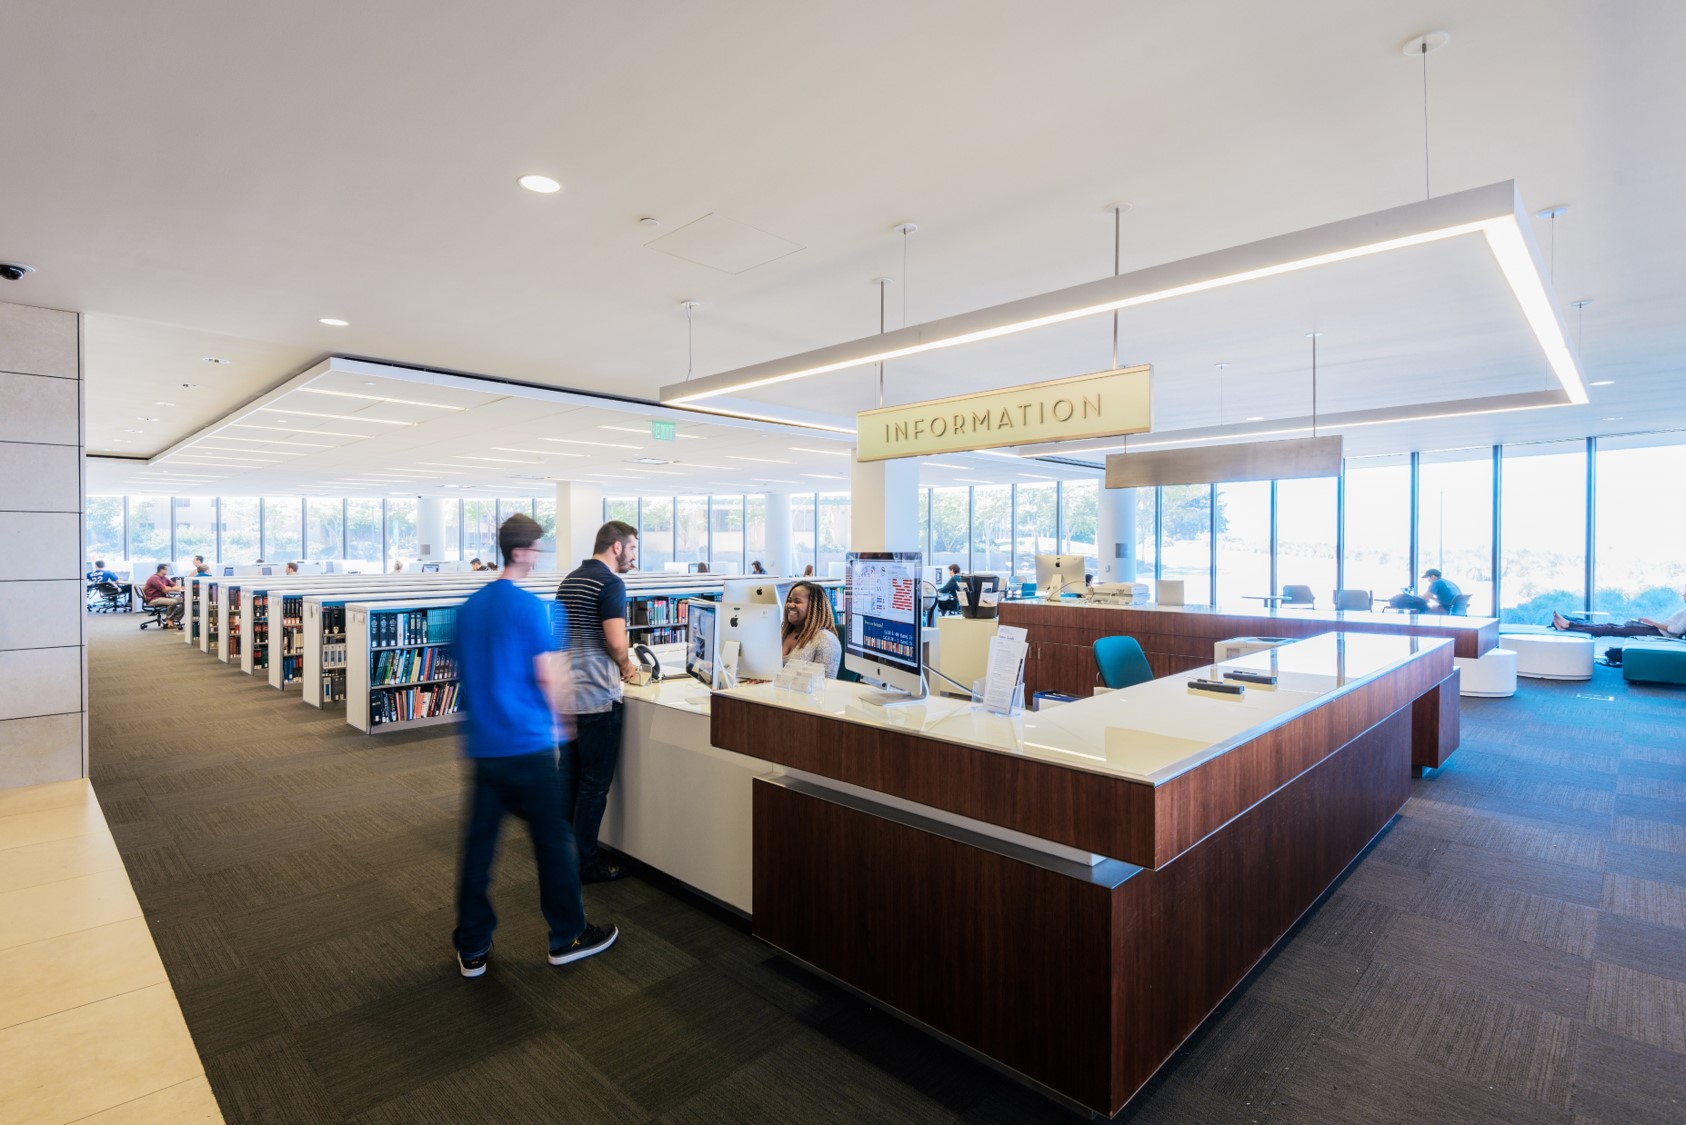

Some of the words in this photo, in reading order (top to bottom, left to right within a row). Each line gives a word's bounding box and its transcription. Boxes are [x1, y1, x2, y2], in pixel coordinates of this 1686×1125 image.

[885, 393, 1101, 443] INFORMATION
[655, 422, 674, 441] EXIT
[91, 575, 103, 584] 22
